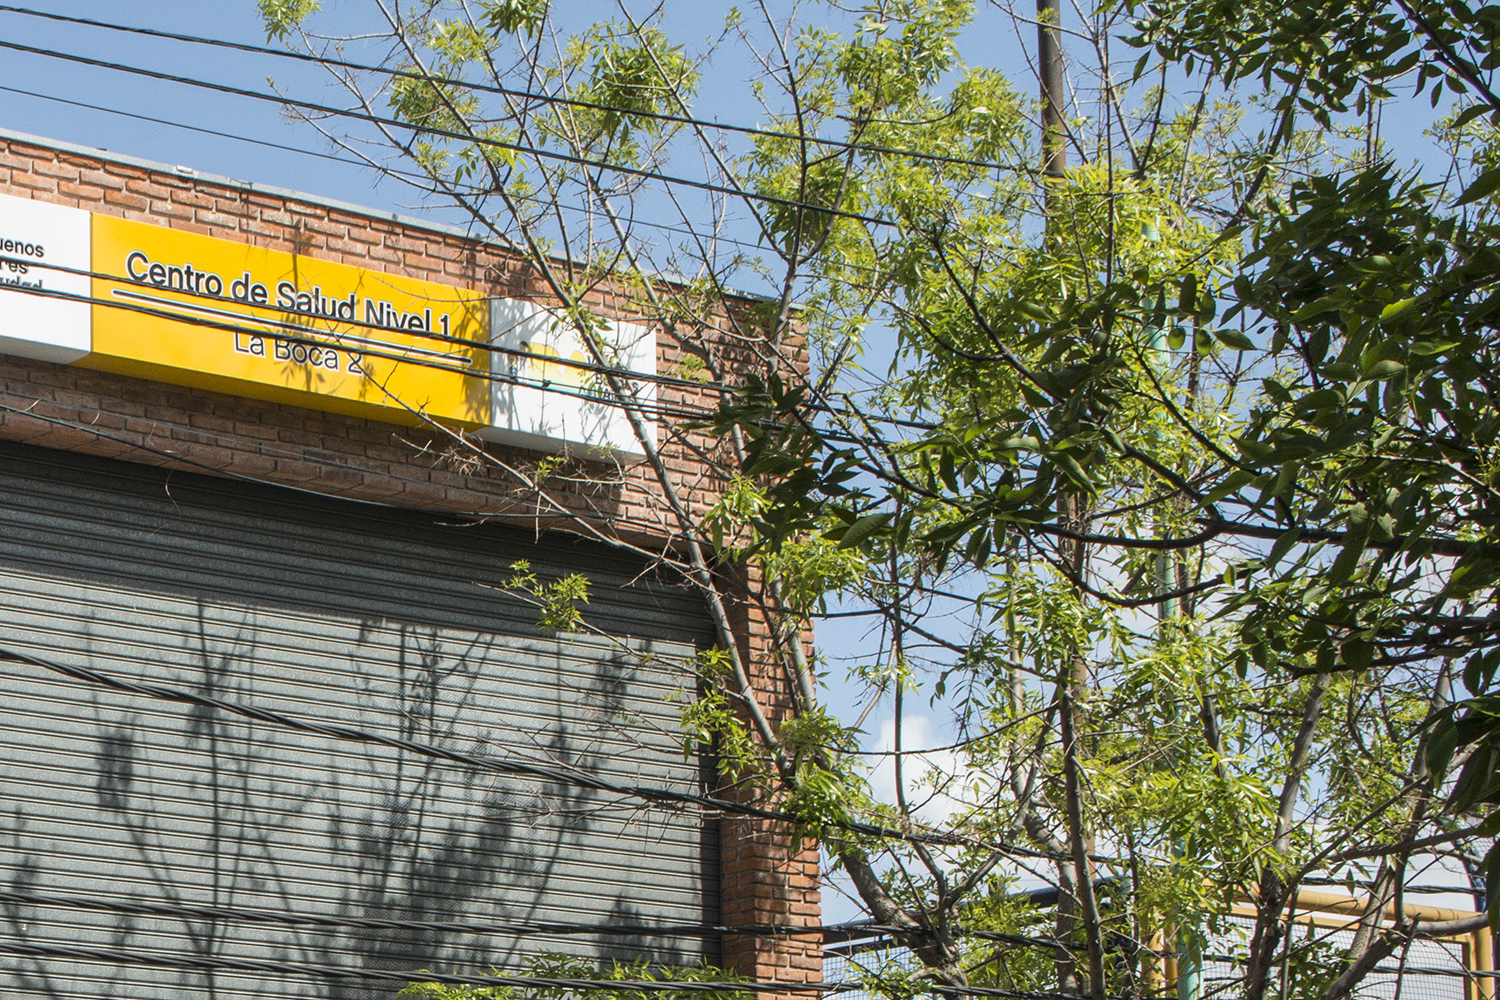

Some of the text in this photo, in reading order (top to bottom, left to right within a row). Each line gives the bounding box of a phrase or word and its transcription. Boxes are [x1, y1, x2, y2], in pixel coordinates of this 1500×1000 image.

[126, 251, 450, 338] Centro de Salud Nivel 1
[234, 330, 266, 358] La
[273, 338, 340, 373] Boca
